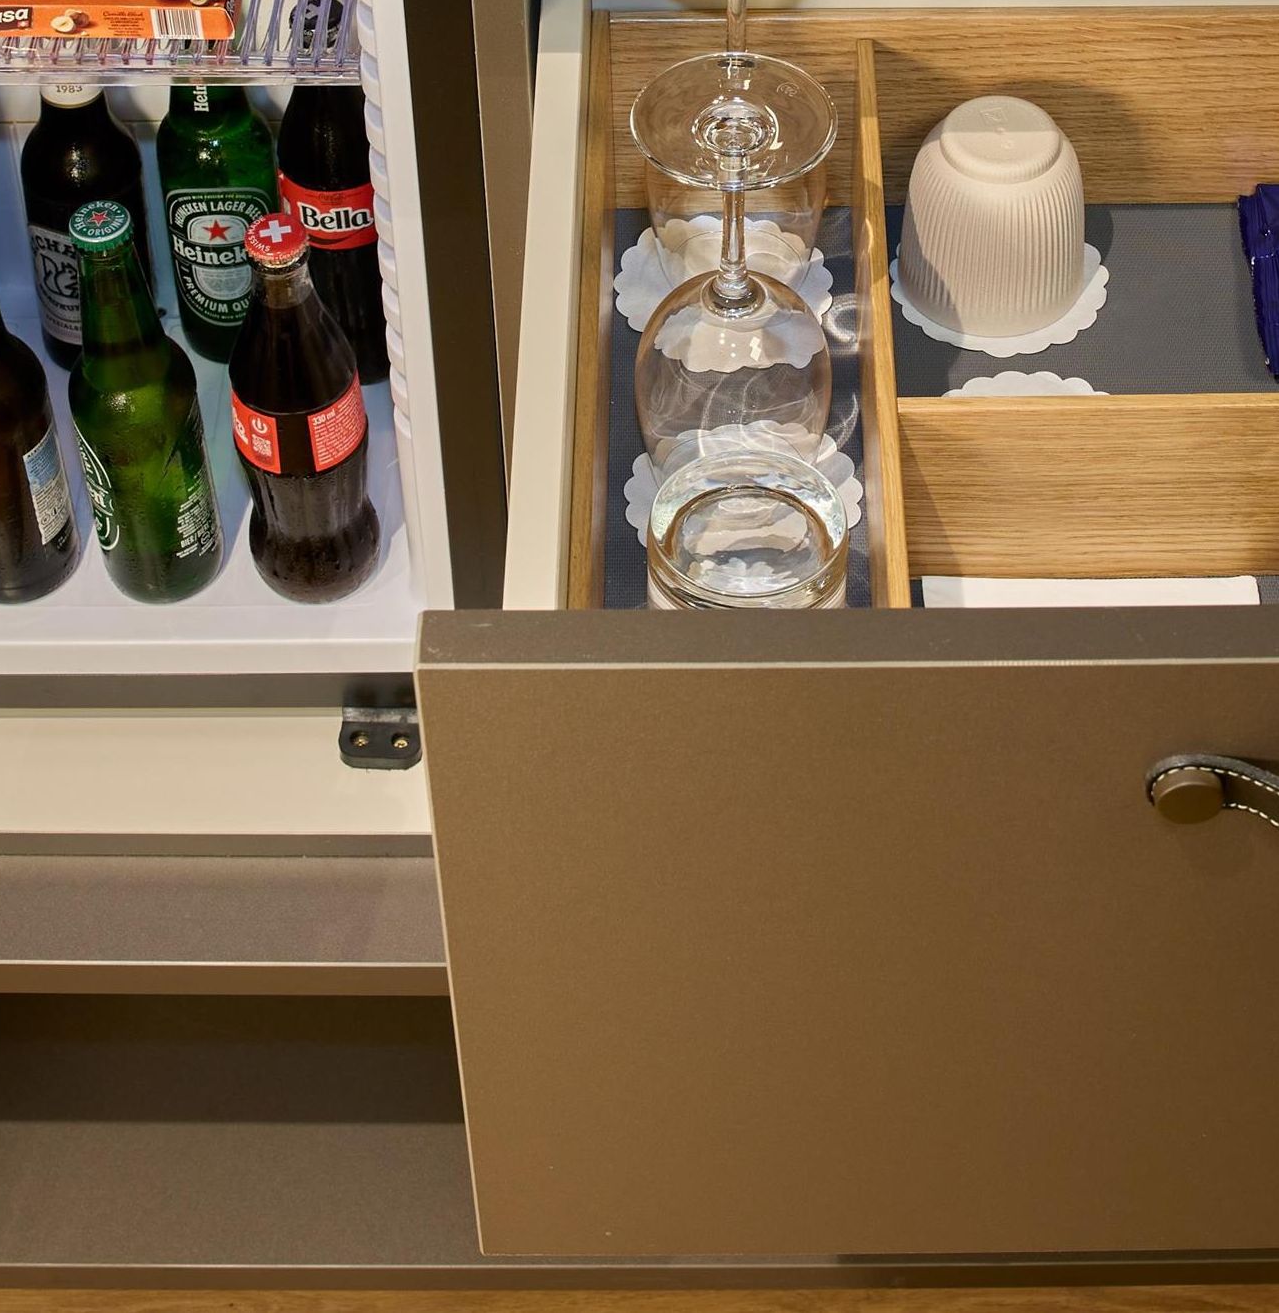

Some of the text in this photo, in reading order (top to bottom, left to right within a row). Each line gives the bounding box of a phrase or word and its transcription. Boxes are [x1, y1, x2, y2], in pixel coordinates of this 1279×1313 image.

[74, 201, 119, 231] Heineken
[87, 214, 125, 236] ORIGINAL
[174, 200, 208, 227] HEINEKEN
[209, 200, 247, 213] LAGER
[298, 202, 373, 232] Bella
[173, 235, 249, 266] Heinek
[248, 235, 271, 253] SWISS
[182, 275, 229, 314] PREMIUM
[312, 415, 326, 426] 330
